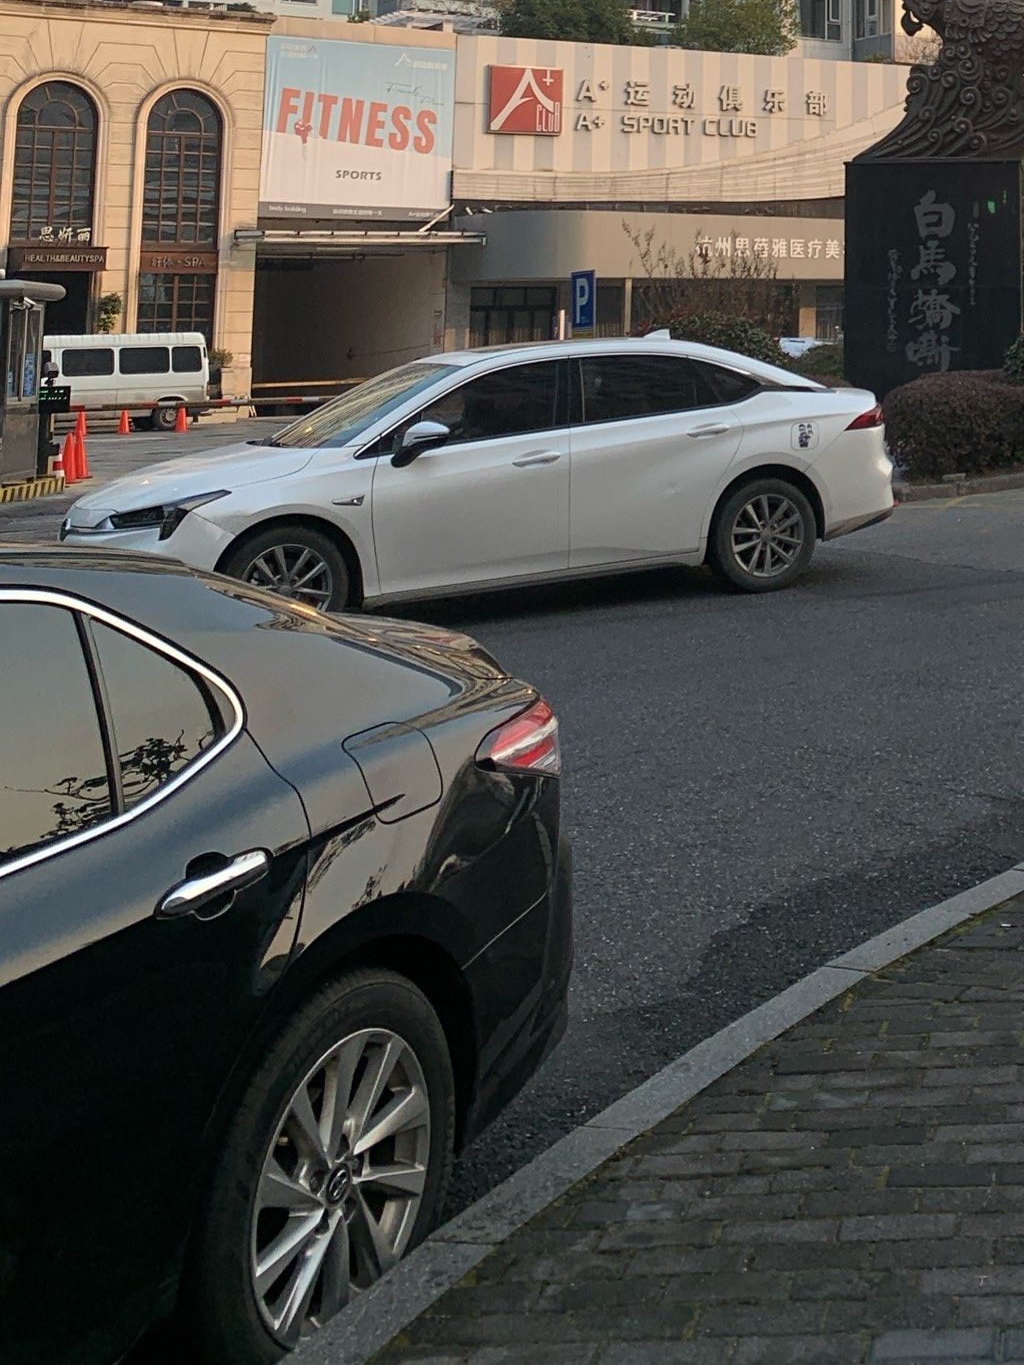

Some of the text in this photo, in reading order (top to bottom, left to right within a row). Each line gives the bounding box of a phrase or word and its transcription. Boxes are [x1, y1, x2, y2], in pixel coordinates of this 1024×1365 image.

[276, 87, 437, 154] FITNESS
[621, 115, 695, 135] SPORT
[703, 118, 758, 137] CLUB
[335, 169, 382, 181] SPORTS
[39, 226, 91, 243] 思妍丽
[576, 278, 589, 324] P
